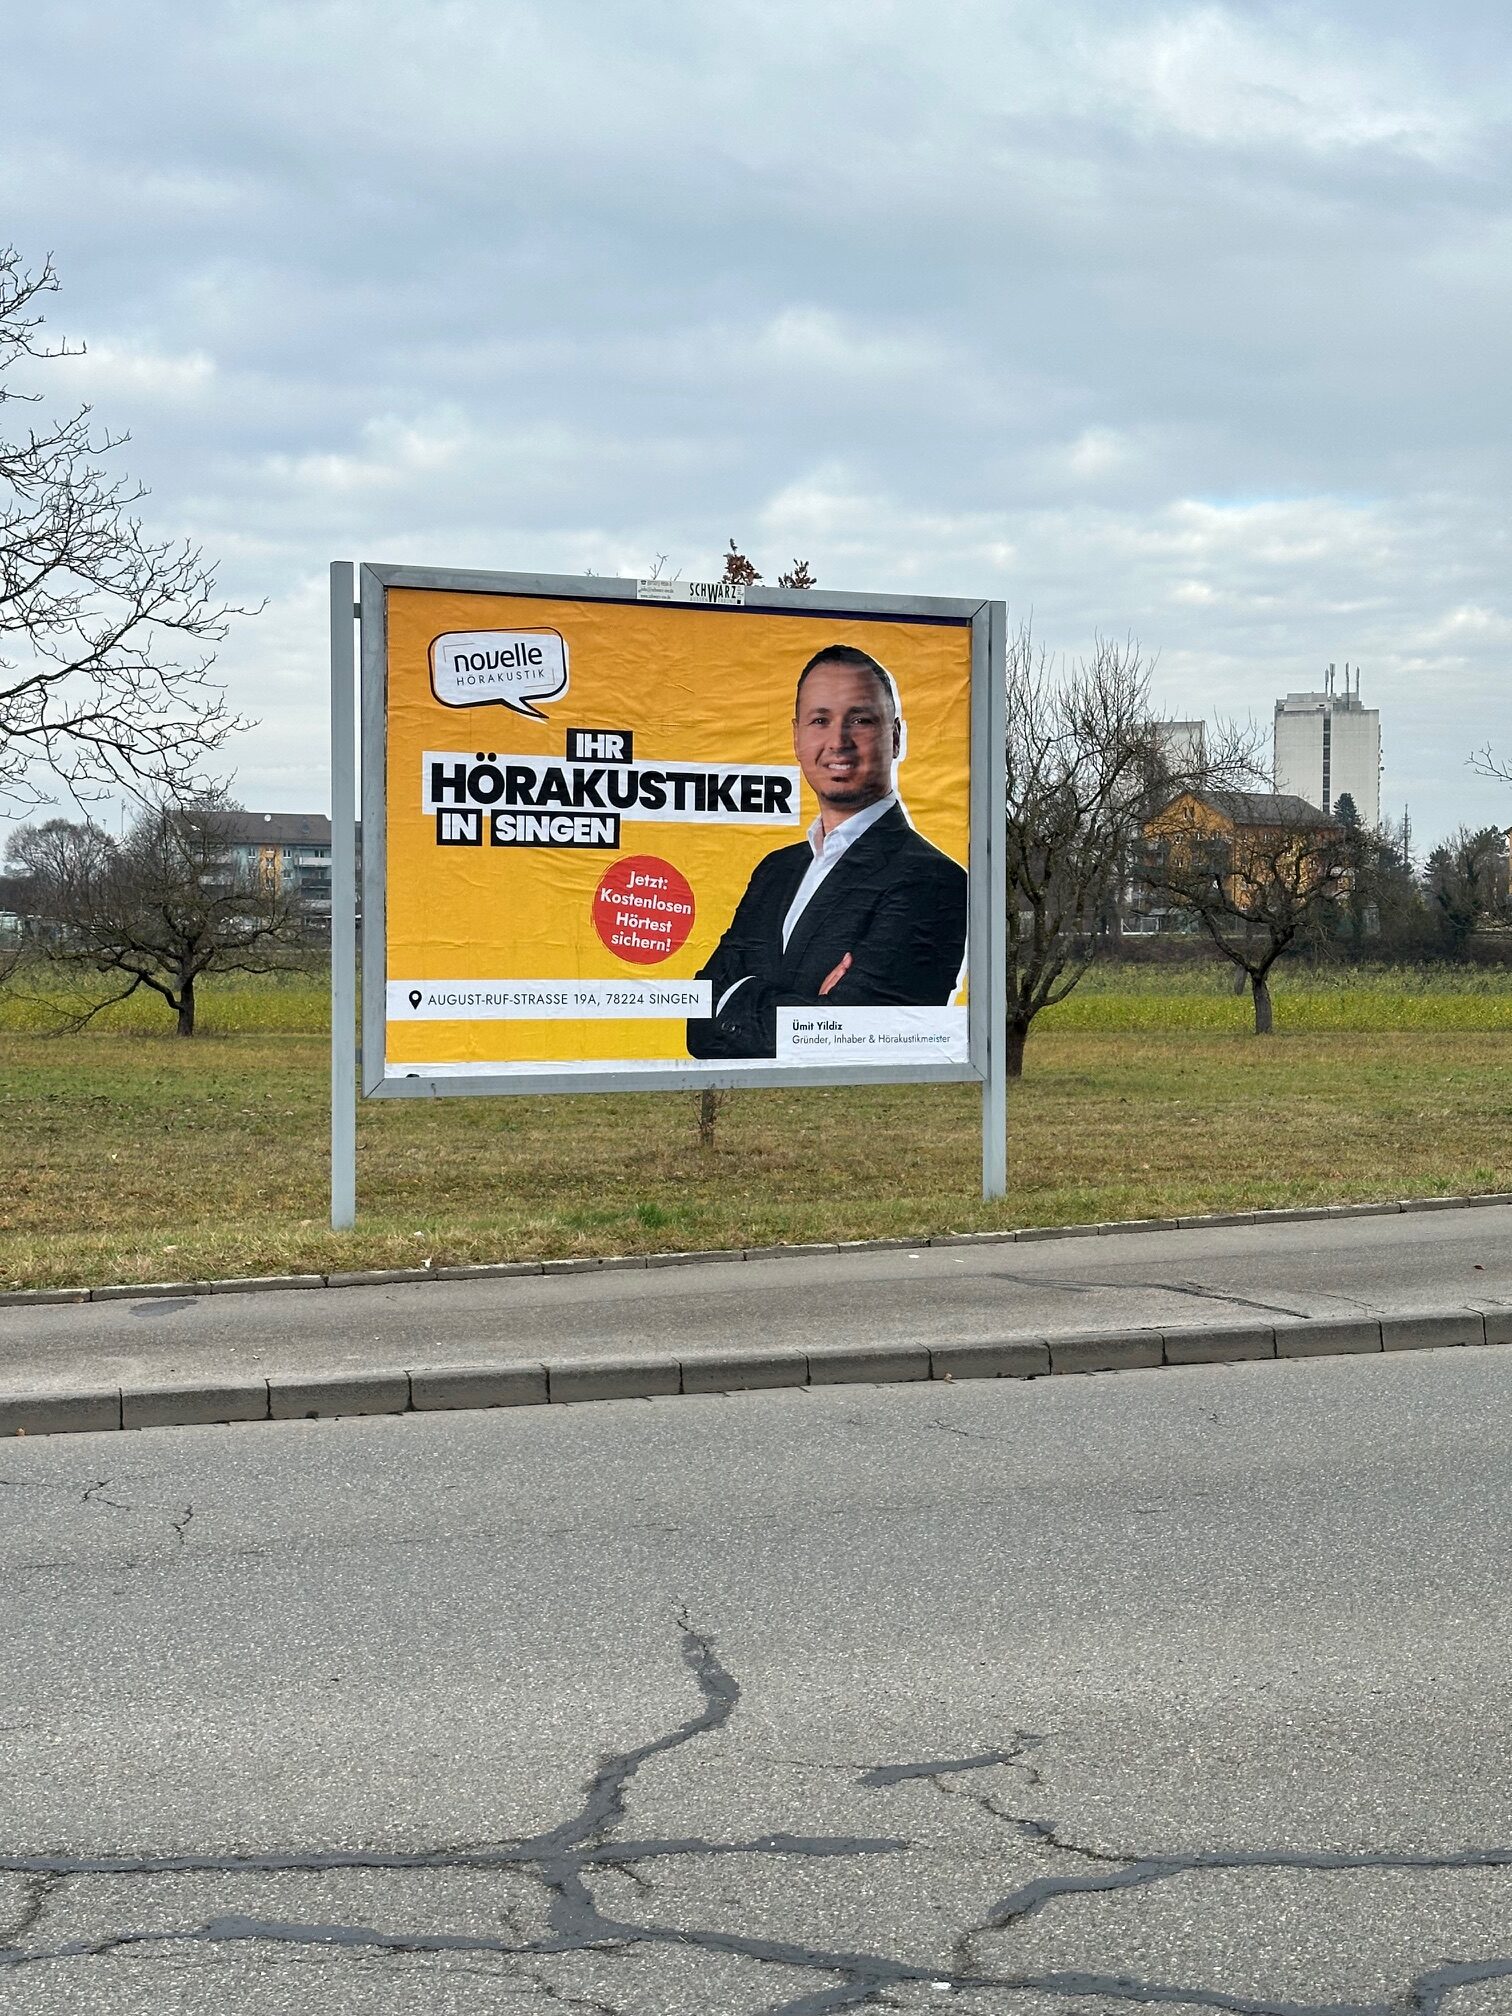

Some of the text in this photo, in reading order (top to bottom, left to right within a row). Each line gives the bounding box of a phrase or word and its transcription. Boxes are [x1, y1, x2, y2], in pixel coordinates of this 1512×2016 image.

[689, 582, 737, 603] SCHWARZ
[453, 642, 543, 673] novelle
[456, 668, 545, 686] HÖRAKUSTIK
[576, 733, 624, 760] IHR
[431, 752, 792, 814] HÖRAKUSTIKER
[442, 812, 615, 844] IN SINGEN
[626, 870, 669, 890] Jetzt:
[600, 887, 692, 915] Kostenlosen
[615, 911, 673, 933] Hörtest
[611, 930, 672, 952] sichern!
[427, 993, 699, 1007] AUGUST-RUF-STRASSE 19A, 78224 SINGEN
[792, 1019, 843, 1031] Ümit Yildiz
[792, 1033, 951, 1046] Gründer, Inhaber & Hörakustikmeister
